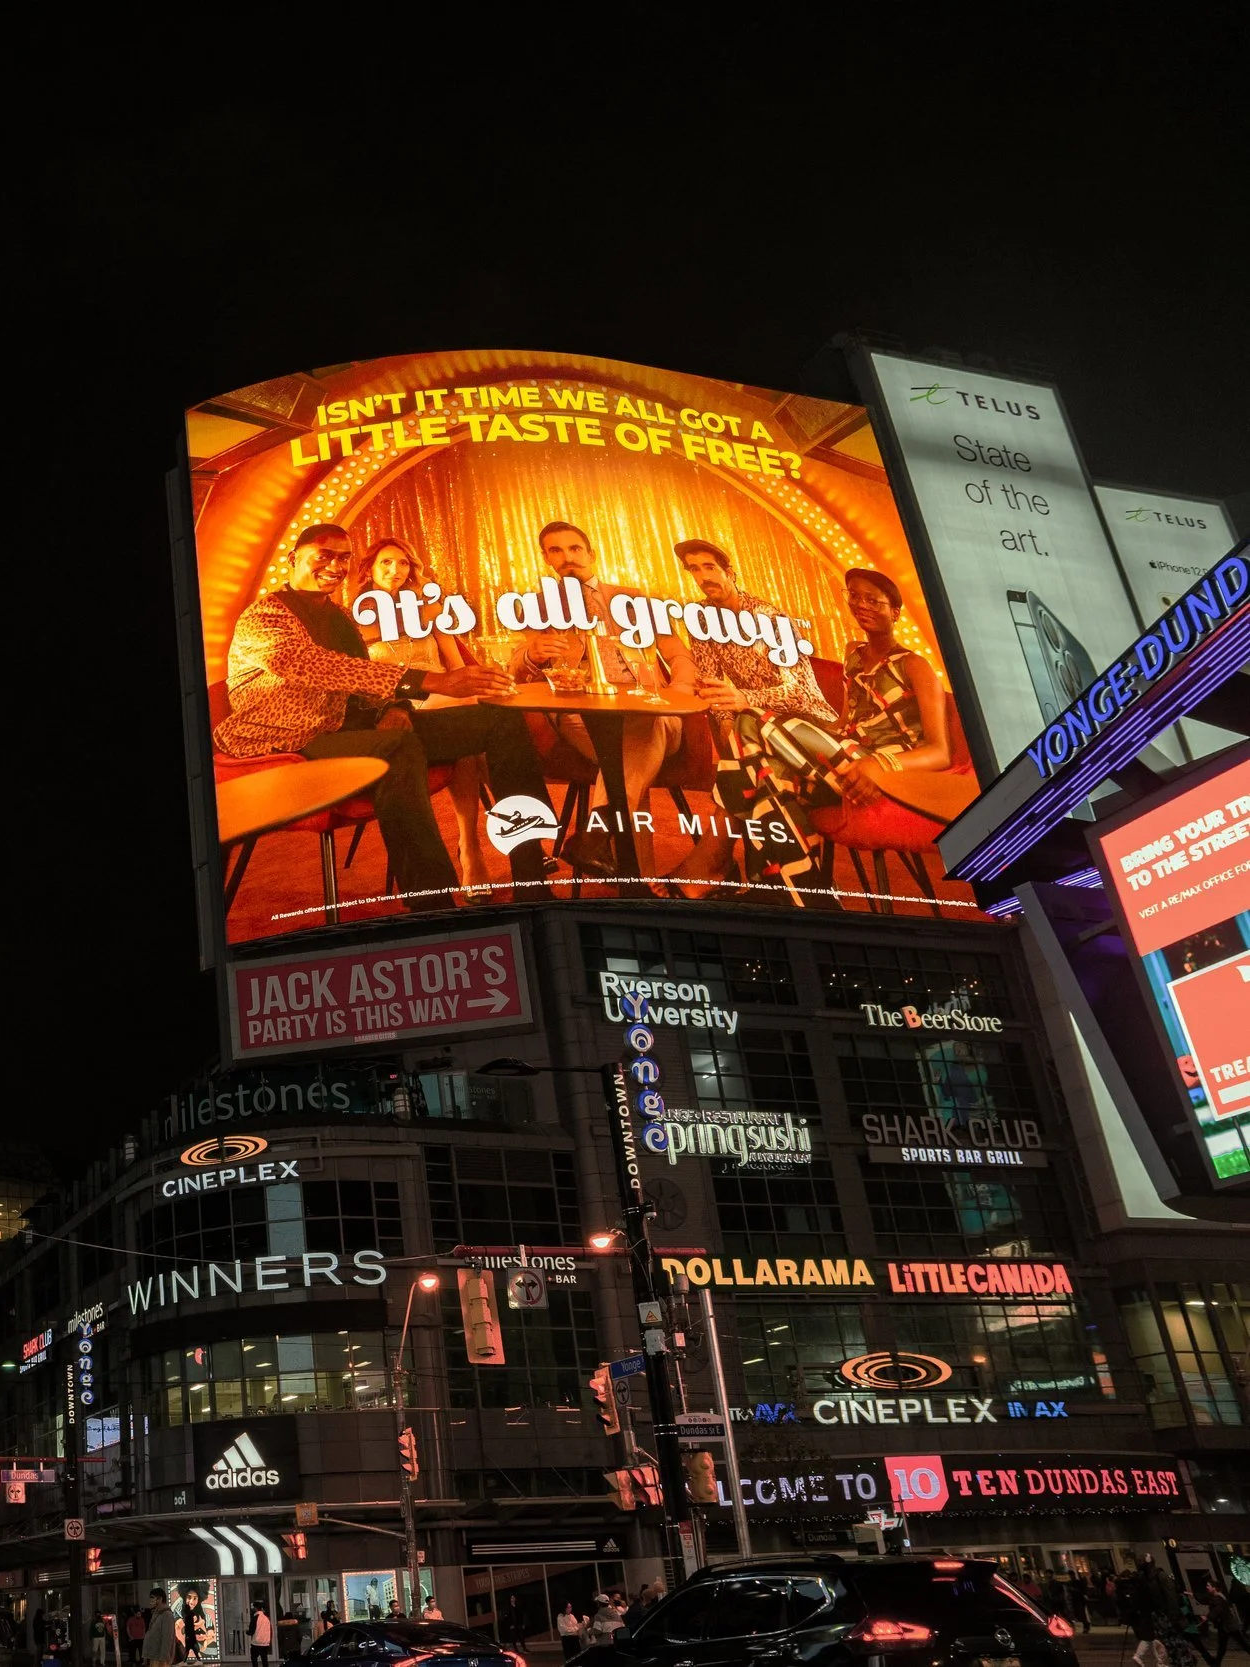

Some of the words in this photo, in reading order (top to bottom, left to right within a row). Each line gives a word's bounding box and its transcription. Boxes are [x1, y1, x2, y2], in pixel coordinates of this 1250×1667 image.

[316, 391, 408, 427] ISN'T
[413, 388, 451, 412] IT
[454, 386, 541, 409] TIME
[547, 387, 609, 413] WE
[614, 396, 676, 425] ALL
[678, 408, 745, 436] GOT
[749, 420, 775, 444] A
[956, 390, 1041, 421] TELUS
[288, 421, 452, 468] LITTLE
[456, 414, 606, 447] TASTE
[612, 422, 676, 455] OF
[680, 432, 803, 479] FREE?
[953, 434, 1032, 473] State
[964, 479, 992, 504] of
[1000, 481, 1051, 516] the
[1154, 511, 1208, 530] TELUS
[999, 529, 1051, 557] art.
[1157, 561, 1191, 575] iPhone
[352, 582, 477, 643] It's
[496, 576, 598, 631] all
[586, 810, 656, 833] AIR
[678, 813, 789, 844] MILES
[1119, 835, 1175, 873] BRING
[1173, 809, 1227, 845] YOUR
[1225, 793, 1250, 819] TR
[1126, 869, 1153, 891] TO
[1152, 850, 1190, 879] THE
[271, 913, 279, 921] All
[280, 909, 304, 919] Rewards
[305, 904, 325, 914] offered
[336, 899, 358, 909] subject
[377, 894, 395, 903] Terms
[408, 888, 441, 898] Conditions
[491, 881, 515, 889] Reward
[554, 877, 576, 885] subject
[1139, 903, 1159, 919] VISIT
[1161, 900, 1168, 909] A
[1167, 884, 1202, 906] RE/MAX
[1202, 870, 1235, 890] OFFICE
[246, 967, 338, 1017] JACK
[348, 945, 507, 1004] ASTOR'S
[599, 971, 711, 1002] Ryerson
[247, 1012, 320, 1044] PARTY
[325, 1009, 347, 1035] IS
[351, 1001, 404, 1031] THIS
[409, 994, 461, 1025] WAY
[604, 996, 739, 1035] Uversity
[613, 1074, 641, 1190] DOWNTOWN
[862, 1113, 963, 1147] SHARK
[968, 1118, 1042, 1149] CLUB
[901, 1147, 952, 1163] SPORTS
[956, 1149, 982, 1164] BAR
[987, 1150, 1023, 1165] GRILL
[162, 1160, 300, 1198] CINEPLEX
[127, 1250, 387, 1316] WINNERS
[556, 1274, 577, 1284] BAR
[662, 1258, 875, 1287] DOLLARAMA
[23, 1336, 38, 1360] SHARK
[39, 1328, 52, 1350] CLUB
[621, 1360, 641, 1374] Yonge
[66, 1364, 75, 1424] DOWNTOWN
[813, 1398, 998, 1425] CINEPLEX
[680, 1425, 708, 1435] Dundas
[11, 1471, 39, 1480] Dundas
[205, 1467, 280, 1490] adidas
[840, 1472, 878, 1500] TO
[893, 1468, 942, 1501] 10
[952, 1469, 1019, 1497] TEN
[1026, 1468, 1129, 1496] DUNDAS
[1135, 1471, 1181, 1497] EAST
